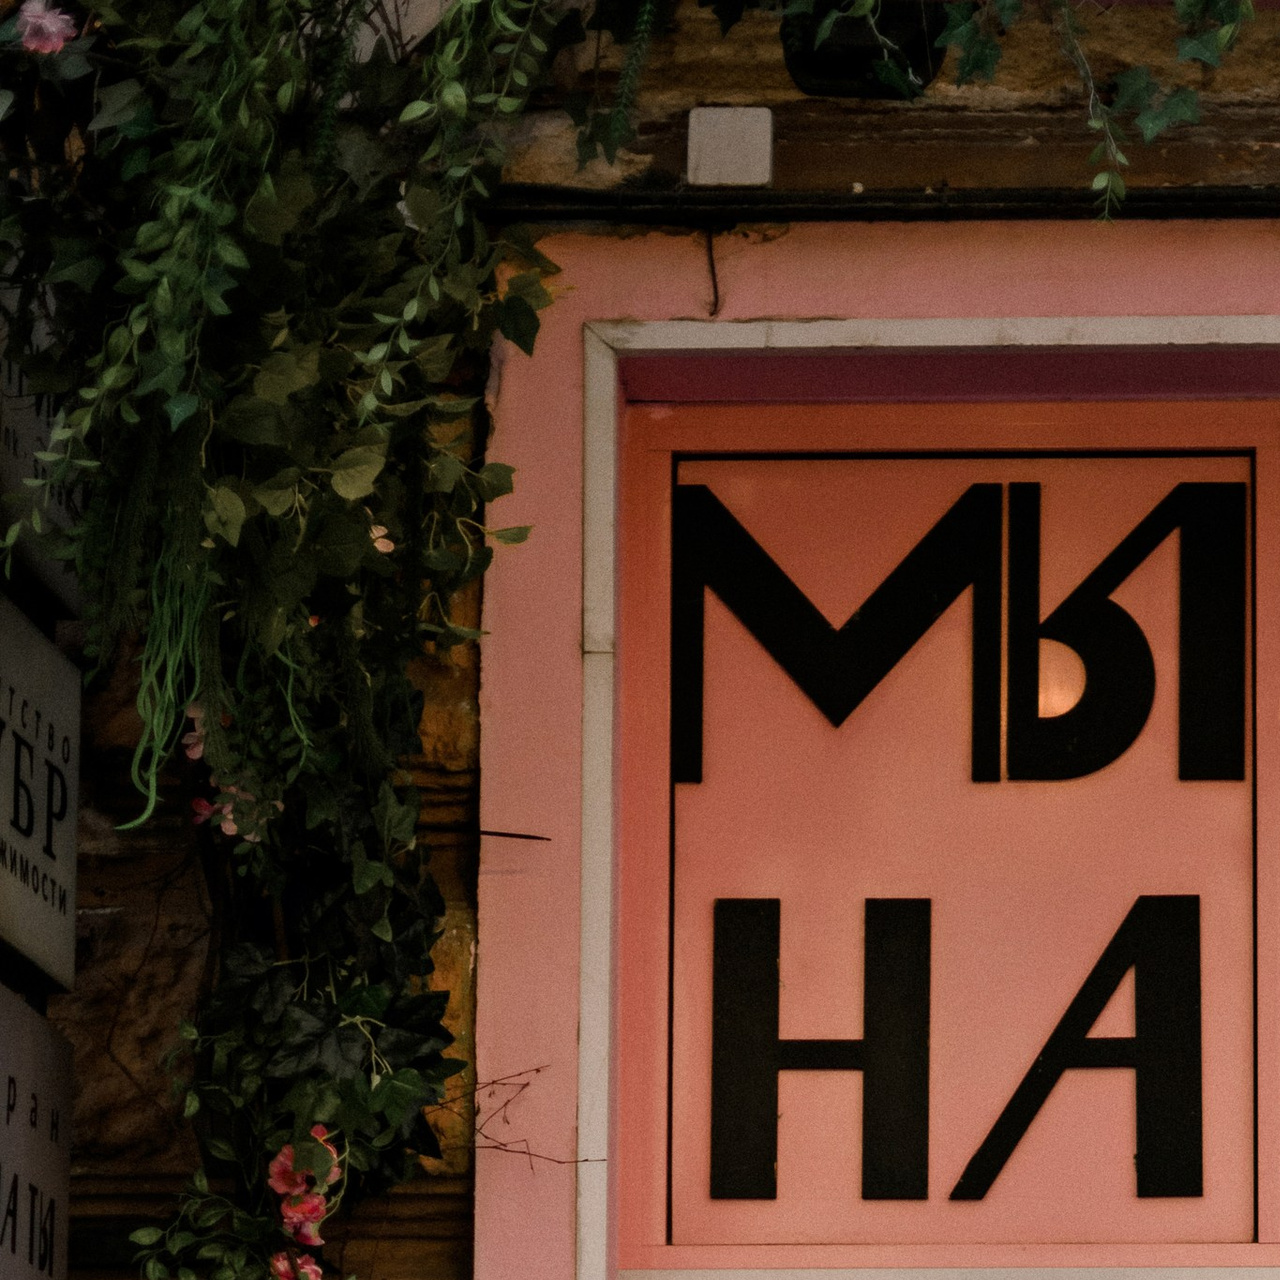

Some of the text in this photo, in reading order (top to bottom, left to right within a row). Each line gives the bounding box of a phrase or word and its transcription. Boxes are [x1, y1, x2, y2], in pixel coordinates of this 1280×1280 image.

[672, 482, 1247, 783] МЫ
[0, 678, 70, 764] ТСТВО
[0, 718, 67, 861] БР
[710, 895, 1203, 1201] НА
[0, 1165, 55, 1278] АТЫ
